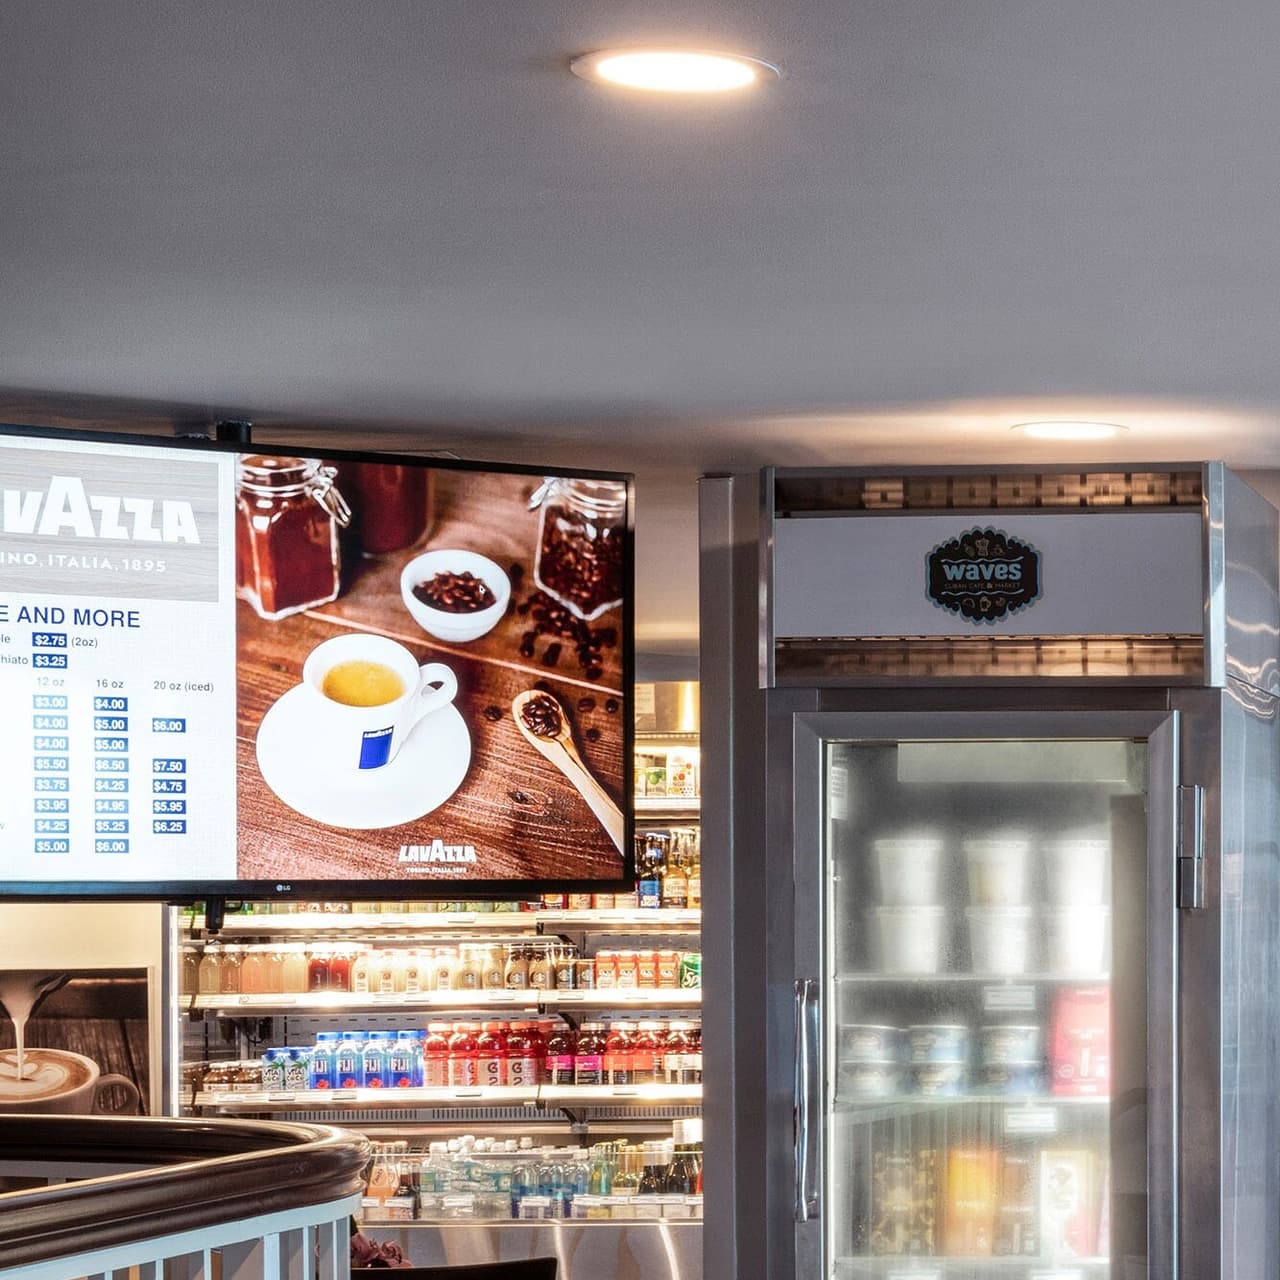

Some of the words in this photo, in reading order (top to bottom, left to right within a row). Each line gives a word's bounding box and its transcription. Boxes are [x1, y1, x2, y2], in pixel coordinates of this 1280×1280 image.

[48, 553, 119, 572] ITALIA,
[121, 558, 167, 574] 1895
[943, 563, 1022, 580] waves
[17, 605, 66, 625] AND
[73, 608, 142, 628] MORE
[34, 635, 66, 647] $2.75
[71, 636, 99, 648] (2oz)
[34, 656, 66, 668] $3.25
[96, 678, 109, 689] 16
[111, 681, 125, 689] oz
[153, 681, 167, 691] 20
[169, 683, 182, 691] oz
[184, 681, 215, 693] (iced)
[94, 699, 125, 710] $4.00
[94, 719, 125, 730] $5.00
[95, 739, 125, 750] $5.00
[153, 761, 184, 772] $7.50
[95, 780, 126, 792] $4.25
[153, 781, 184, 792] $4.75
[153, 801, 184, 813] $5.95
[36, 821, 67, 832] $4.25
[95, 821, 126, 832] $5.25
[153, 822, 184, 833] $6.25
[36, 841, 68, 853] $5.00
[95, 841, 126, 853] $6.00
[399, 839, 478, 863] LAVAZZA
[313, 1060, 327, 1073] FIJI
[338, 1059, 354, 1073] FIJI
[365, 1058, 381, 1073] FIJI
[390, 1058, 409, 1073] FIJI
